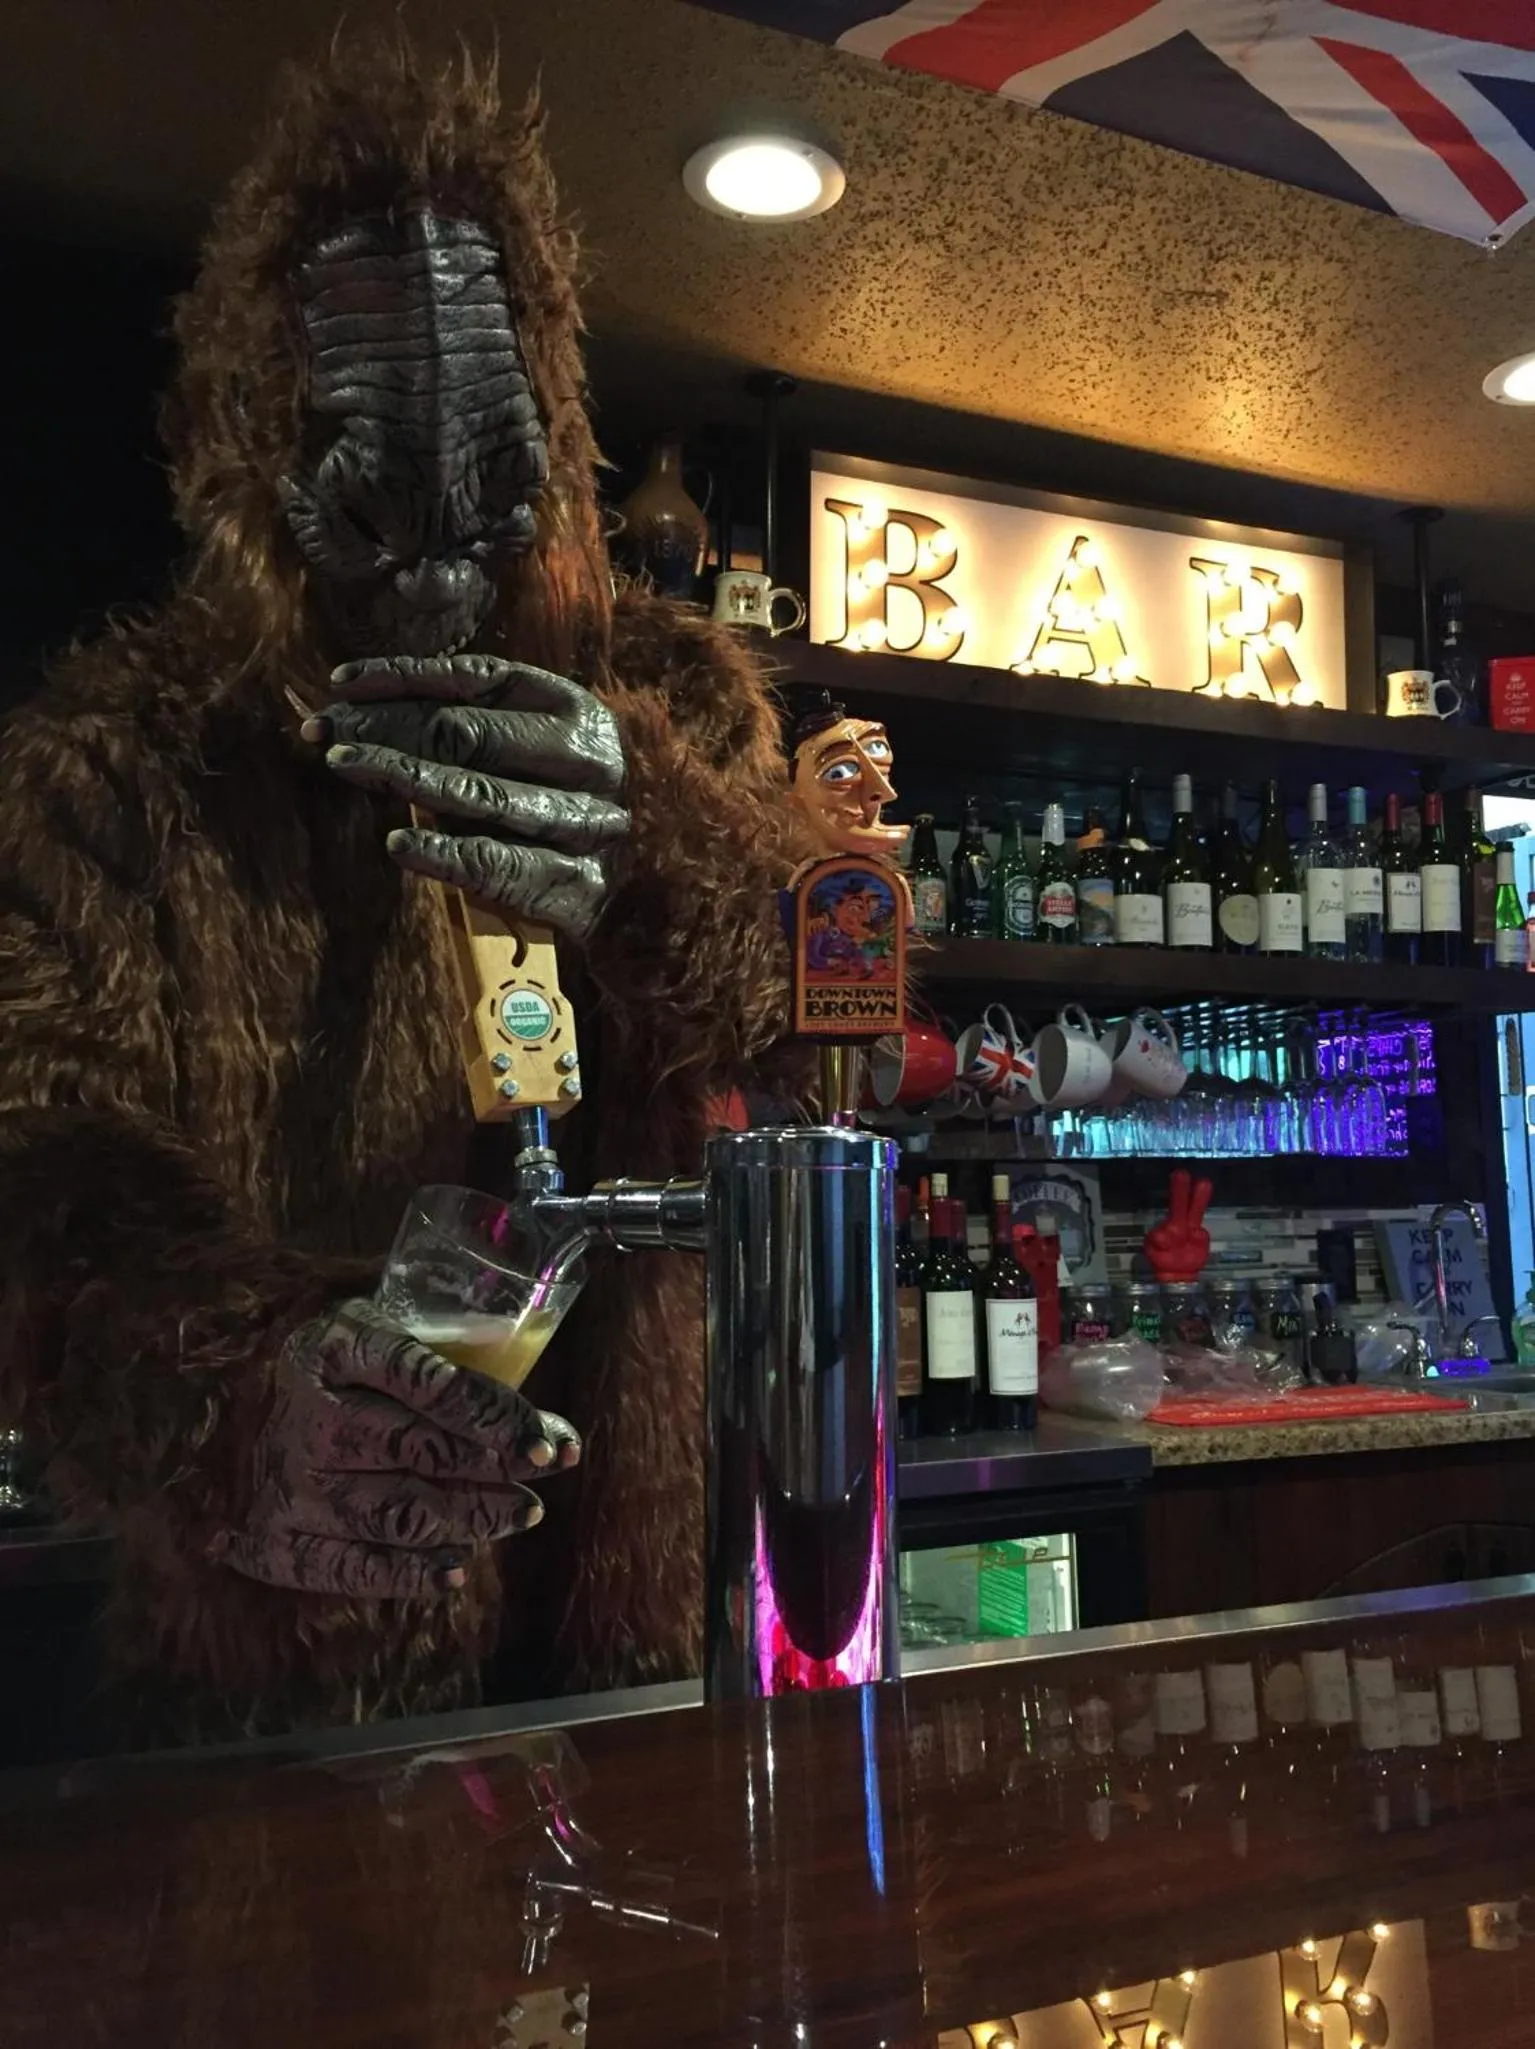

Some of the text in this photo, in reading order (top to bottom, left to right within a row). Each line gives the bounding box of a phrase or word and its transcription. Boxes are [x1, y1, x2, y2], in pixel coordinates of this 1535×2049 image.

[823, 497, 1324, 708] BAR
[806, 988, 897, 999] DOWNTOWN
[511, 1001, 540, 1012] USDA
[806, 1000, 897, 1019] BROWN
[510, 1017, 546, 1026] ORGANIC
